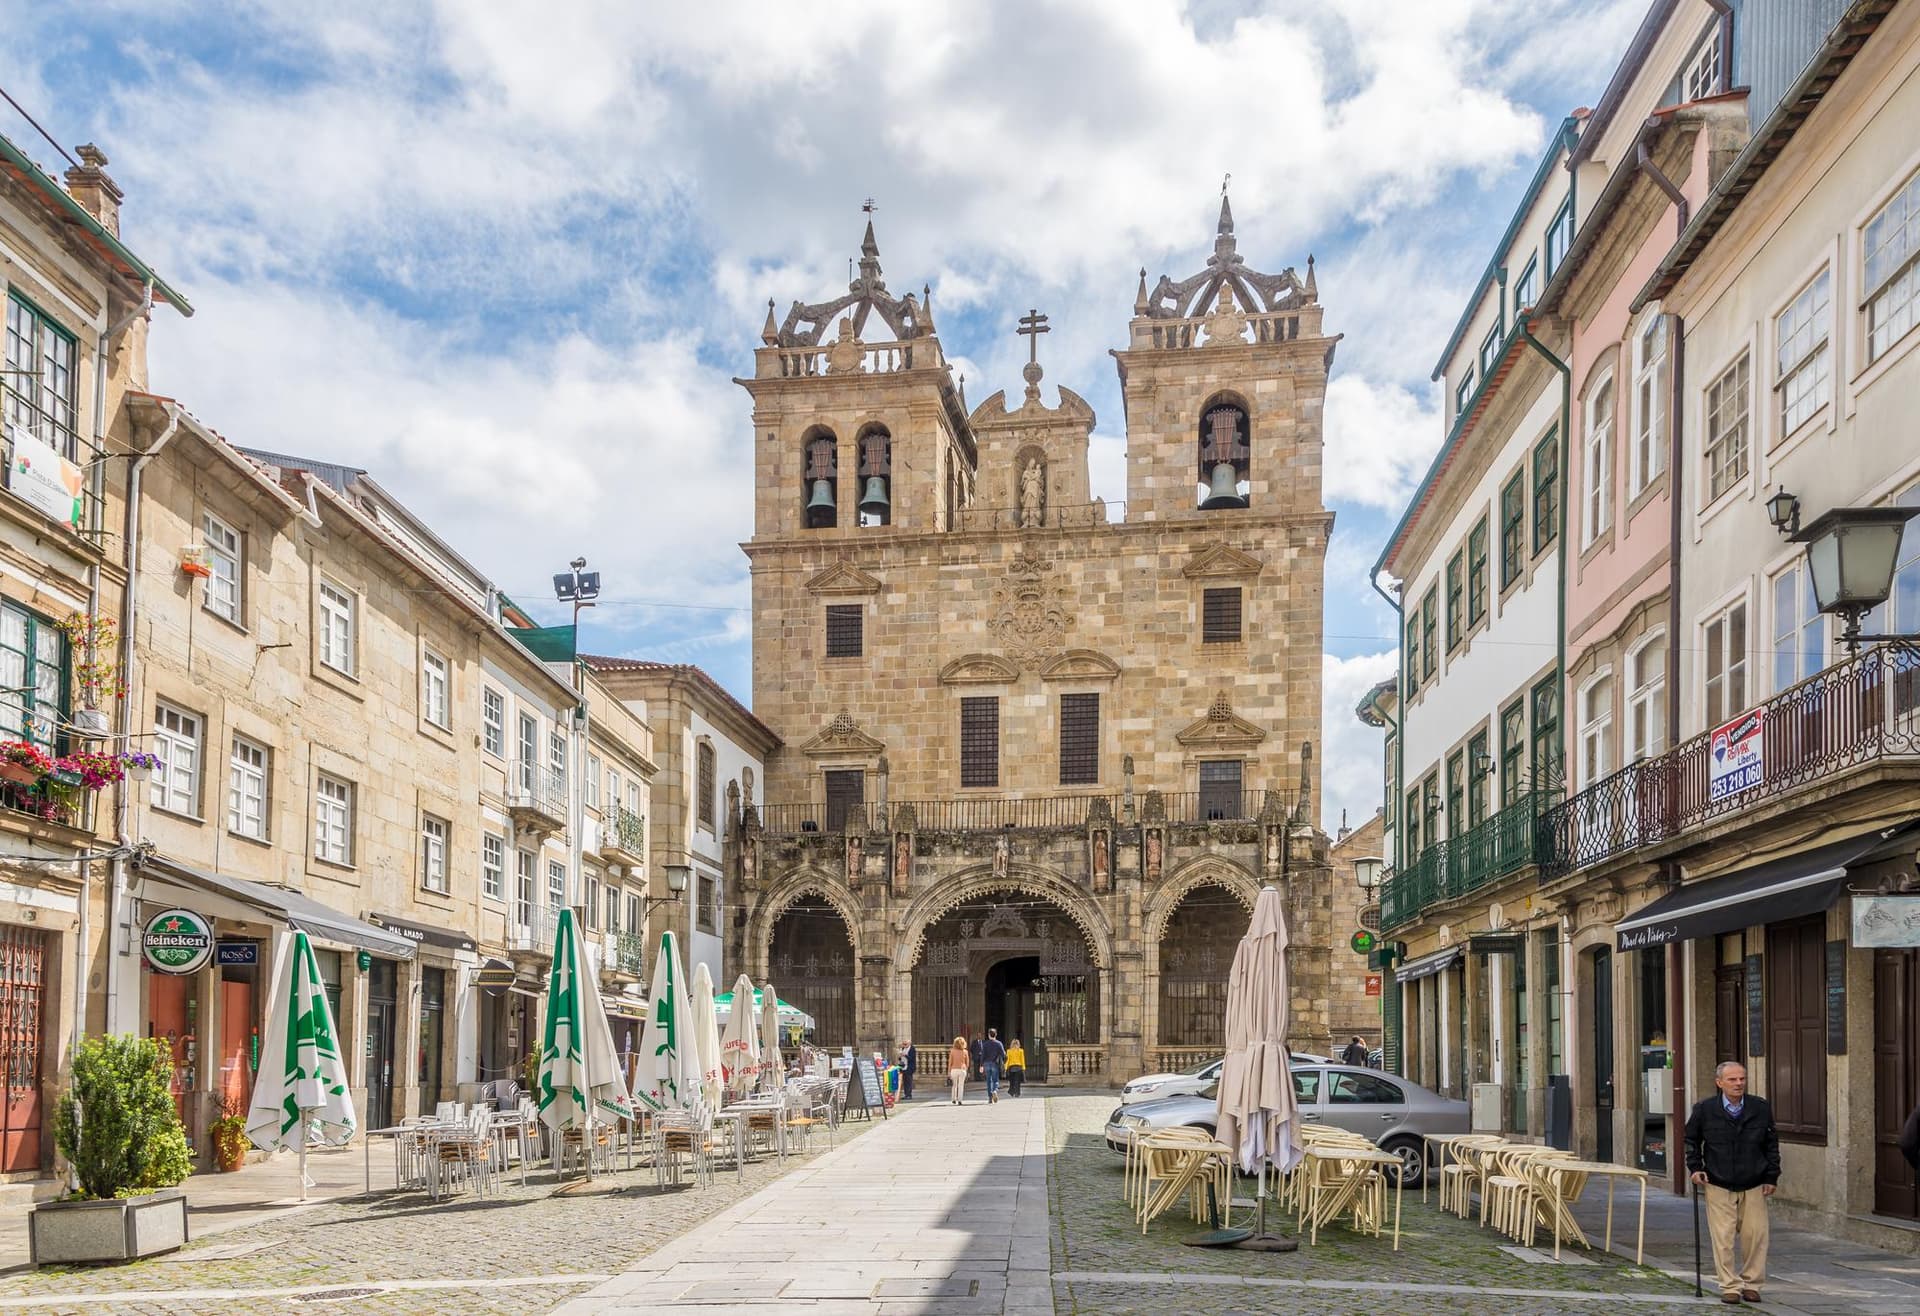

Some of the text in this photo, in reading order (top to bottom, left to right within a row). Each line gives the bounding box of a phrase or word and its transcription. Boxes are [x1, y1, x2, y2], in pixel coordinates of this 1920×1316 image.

[1731, 716, 1756, 743] VENDIDO
[1737, 751, 1757, 766] Liberty
[1712, 763, 1761, 798] 253 218 060
[146, 935, 205, 947] Heineken
[389, 925, 424, 940] MAL AMADO
[601, 1098, 632, 1117] Heineken
